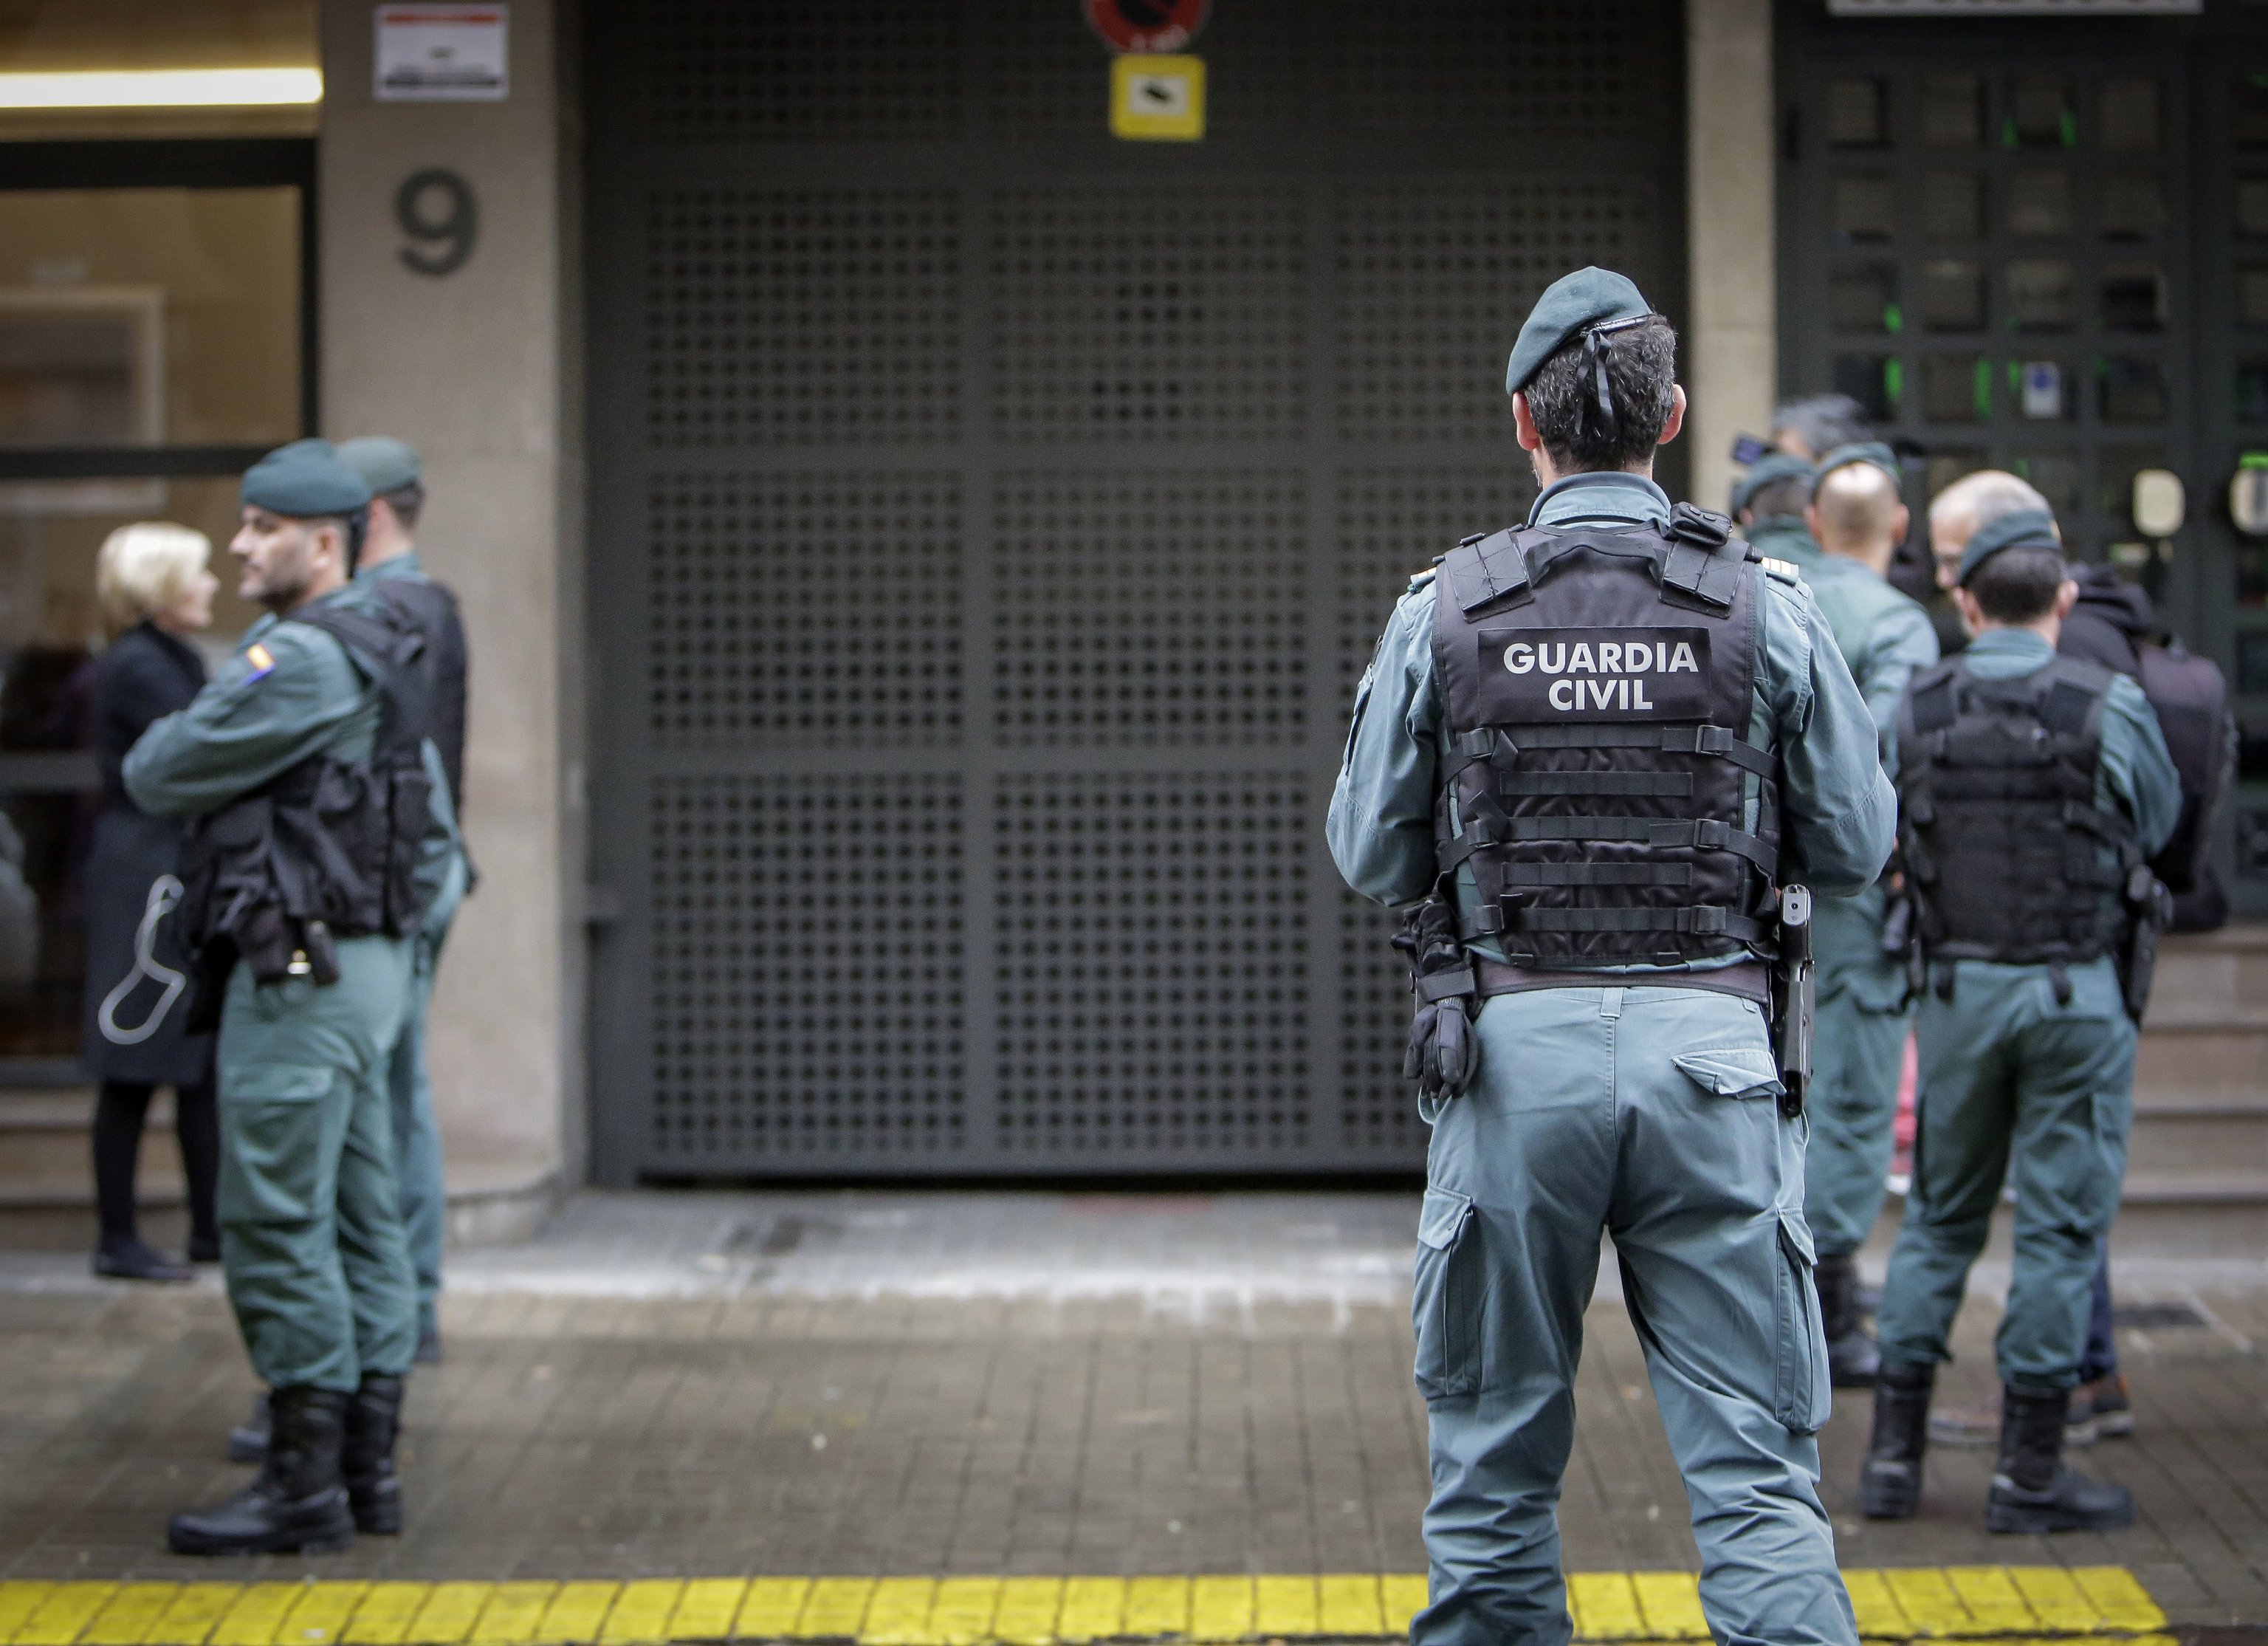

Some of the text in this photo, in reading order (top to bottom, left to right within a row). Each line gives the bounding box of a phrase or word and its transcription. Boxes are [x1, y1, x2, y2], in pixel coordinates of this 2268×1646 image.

[395, 166, 478, 276] 9
[1503, 642, 1699, 675] GUARDIA
[1548, 679, 1653, 711] CIVIL
